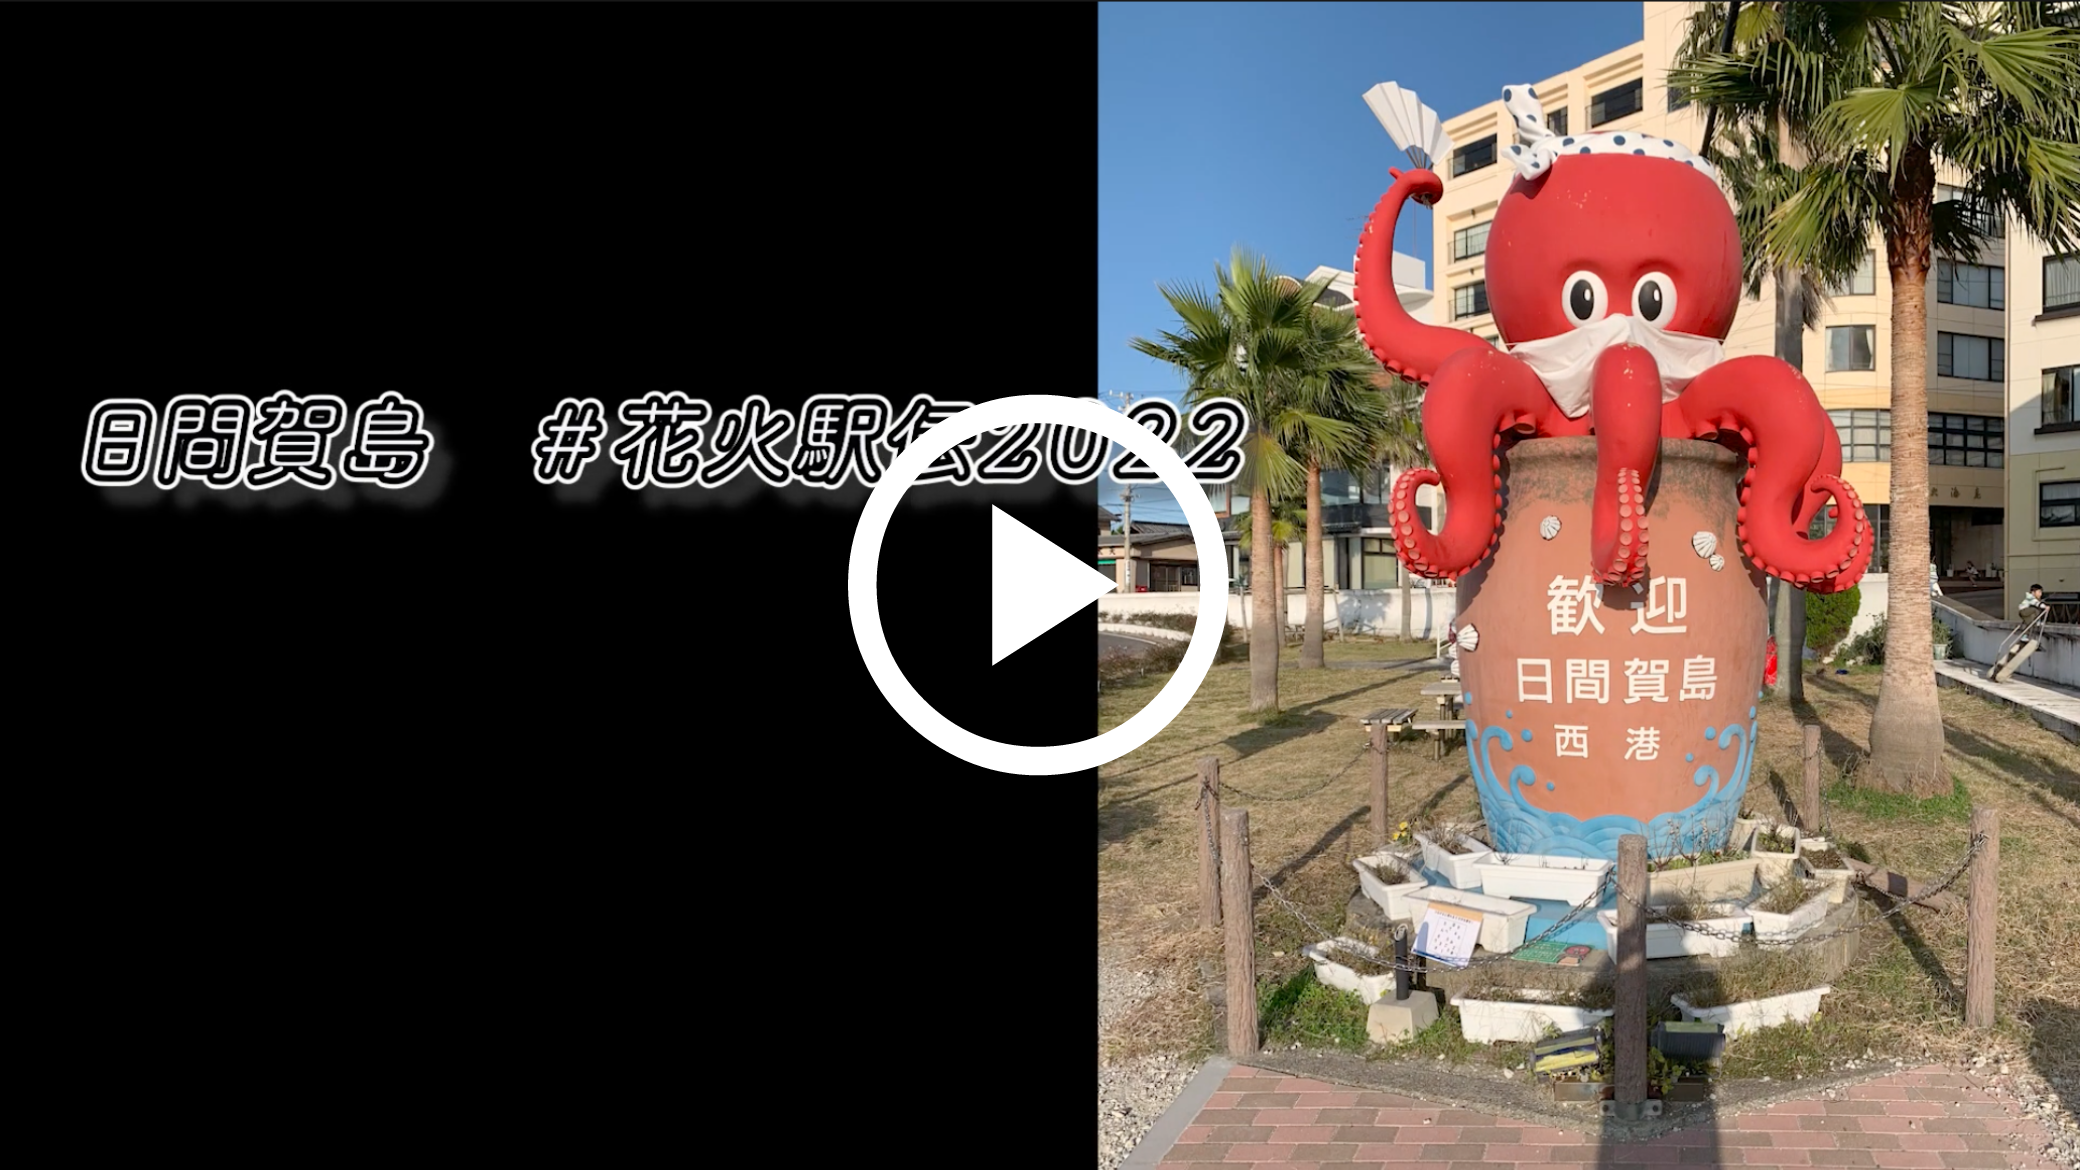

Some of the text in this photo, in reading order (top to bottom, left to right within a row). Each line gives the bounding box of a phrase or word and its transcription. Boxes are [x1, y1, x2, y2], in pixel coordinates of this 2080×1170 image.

[1546, 574, 1687, 636] 歓迎
[1516, 654, 1718, 704] 日間賀島
[1554, 724, 1661, 761] 西港
